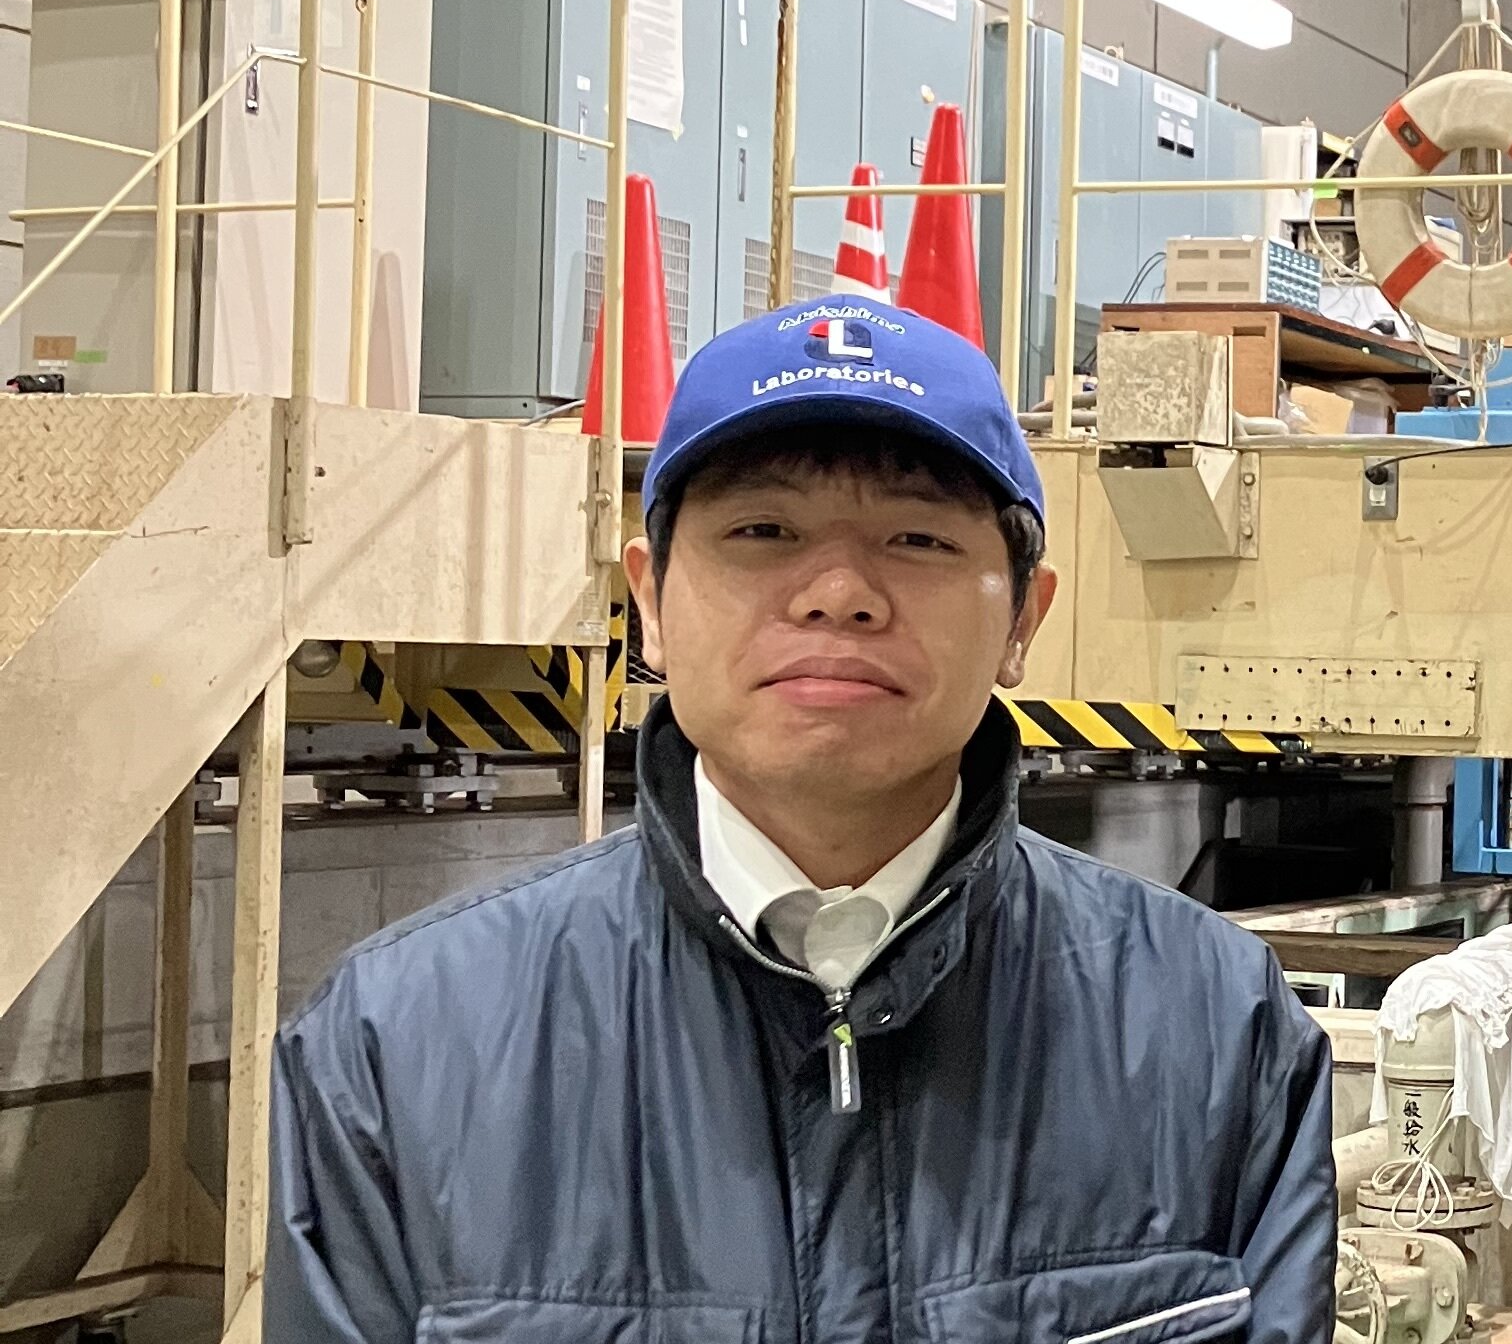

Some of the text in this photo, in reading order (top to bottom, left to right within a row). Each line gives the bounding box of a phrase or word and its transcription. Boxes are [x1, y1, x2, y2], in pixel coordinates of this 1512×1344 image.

[752, 365, 926, 396] Laboratories
[1401, 1092, 1424, 1156] 一般給水
